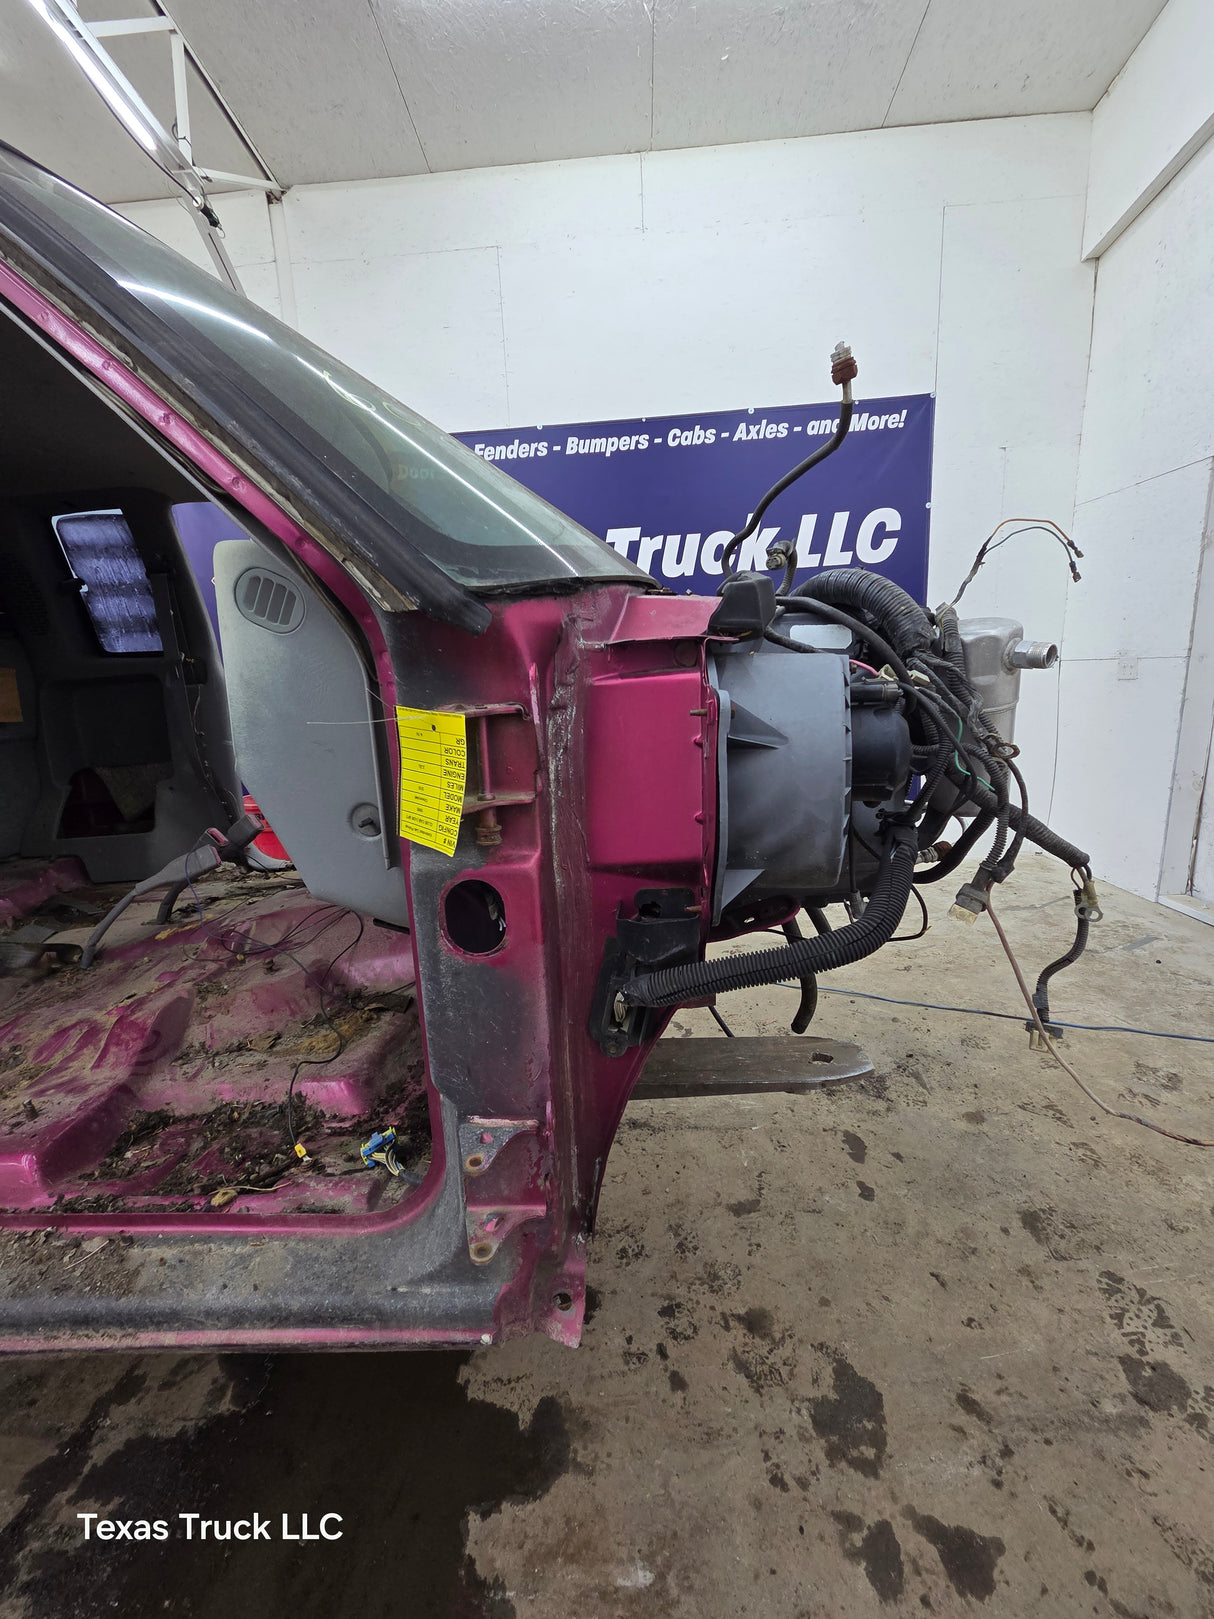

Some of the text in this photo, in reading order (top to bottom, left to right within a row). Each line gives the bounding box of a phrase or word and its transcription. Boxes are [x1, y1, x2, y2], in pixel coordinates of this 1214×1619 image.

[474, 439, 548, 461] Fenders
[565, 434, 649, 457] Bumpers
[667, 425, 717, 447] Cabs
[732, 419, 789, 441] Axles
[848, 409, 908, 432] More!
[605, 507, 902, 578] Truck LLC
[444, 746, 465, 757] COLOR
[445, 758, 465, 769] TRANS
[443, 769, 465, 780] ENGINE
[447, 781, 464, 791] MILES
[443, 791, 462, 803] MODEL
[445, 803, 461, 814] MAKE
[445, 815, 459, 825] YEAR
[438, 824, 458, 837] CONFIG
[447, 838, 455, 848] VIN
